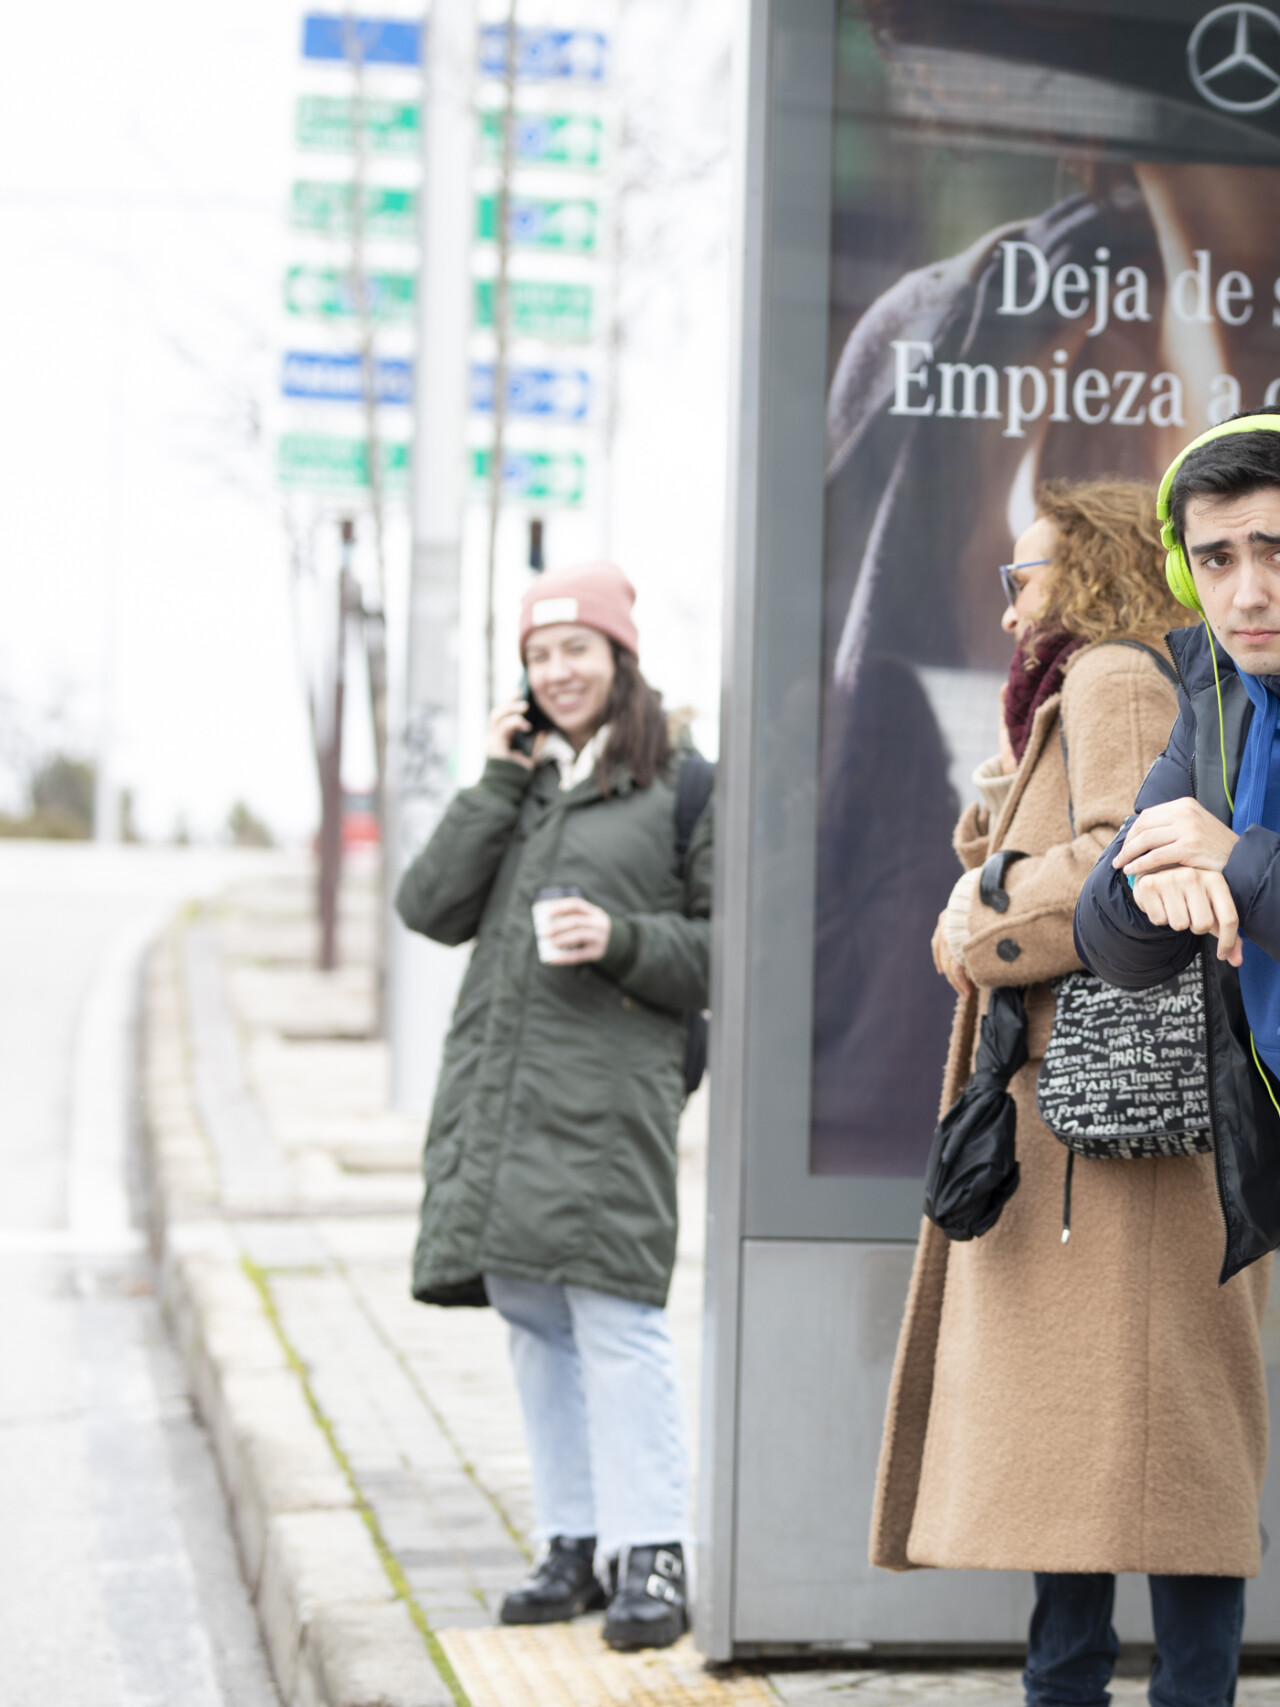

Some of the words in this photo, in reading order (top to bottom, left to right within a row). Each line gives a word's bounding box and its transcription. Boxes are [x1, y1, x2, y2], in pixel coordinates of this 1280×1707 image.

[997, 240, 1151, 337] Deja
[1174, 249, 1254, 327] de
[888, 340, 1187, 438] Empieza
[1207, 374, 1242, 427] a
[1157, 989, 1202, 1016] PARIS
[1108, 1029, 1155, 1050] PARIS
[1076, 1076, 1128, 1093] PARIS
[1135, 1091, 1180, 1104] FRANCE
